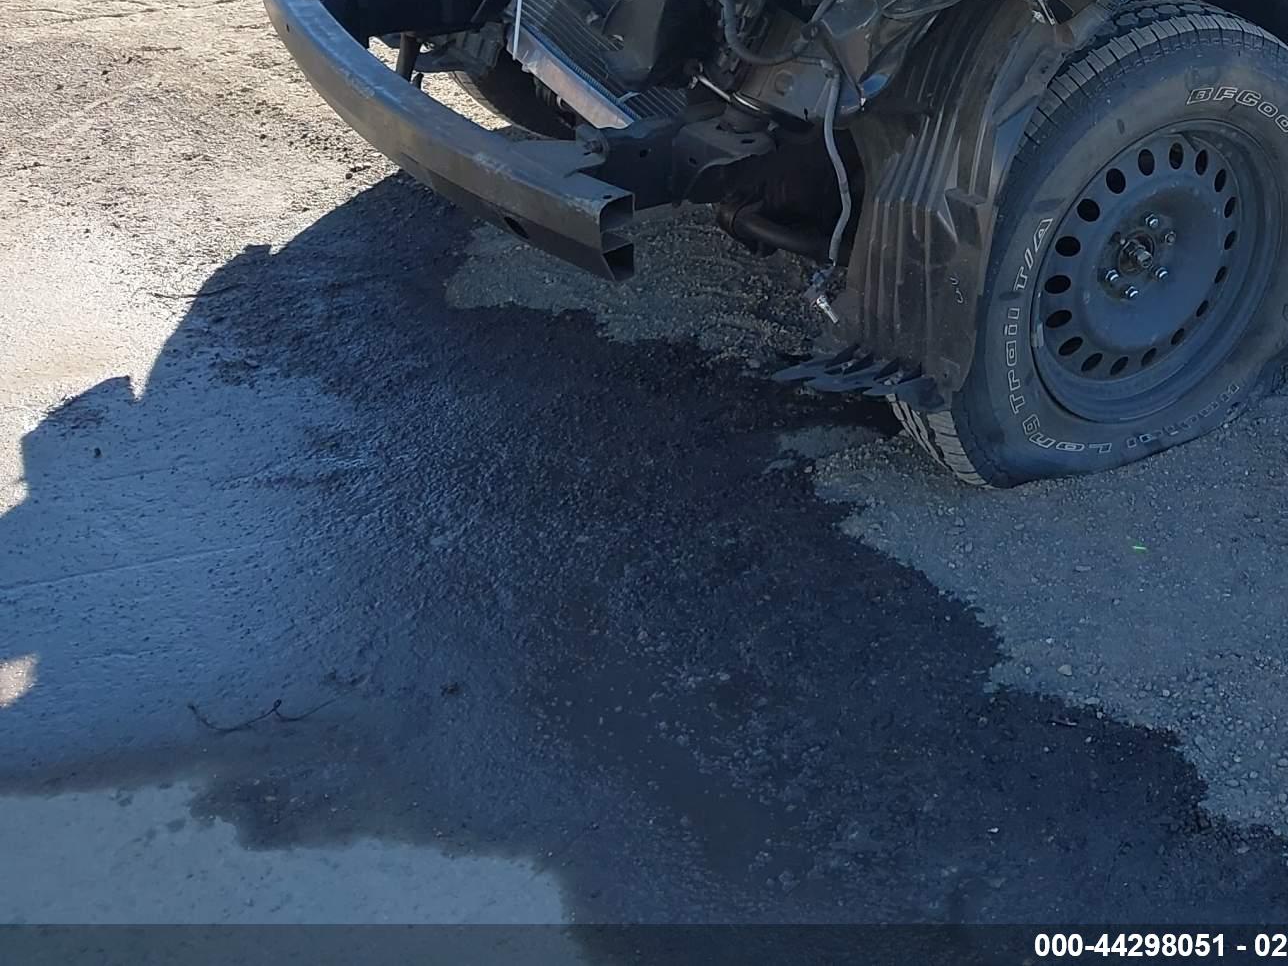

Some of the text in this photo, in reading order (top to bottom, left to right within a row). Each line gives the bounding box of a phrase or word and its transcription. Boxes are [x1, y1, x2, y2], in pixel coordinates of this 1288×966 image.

[1004, 217, 1113, 454] Long Trail T/A
